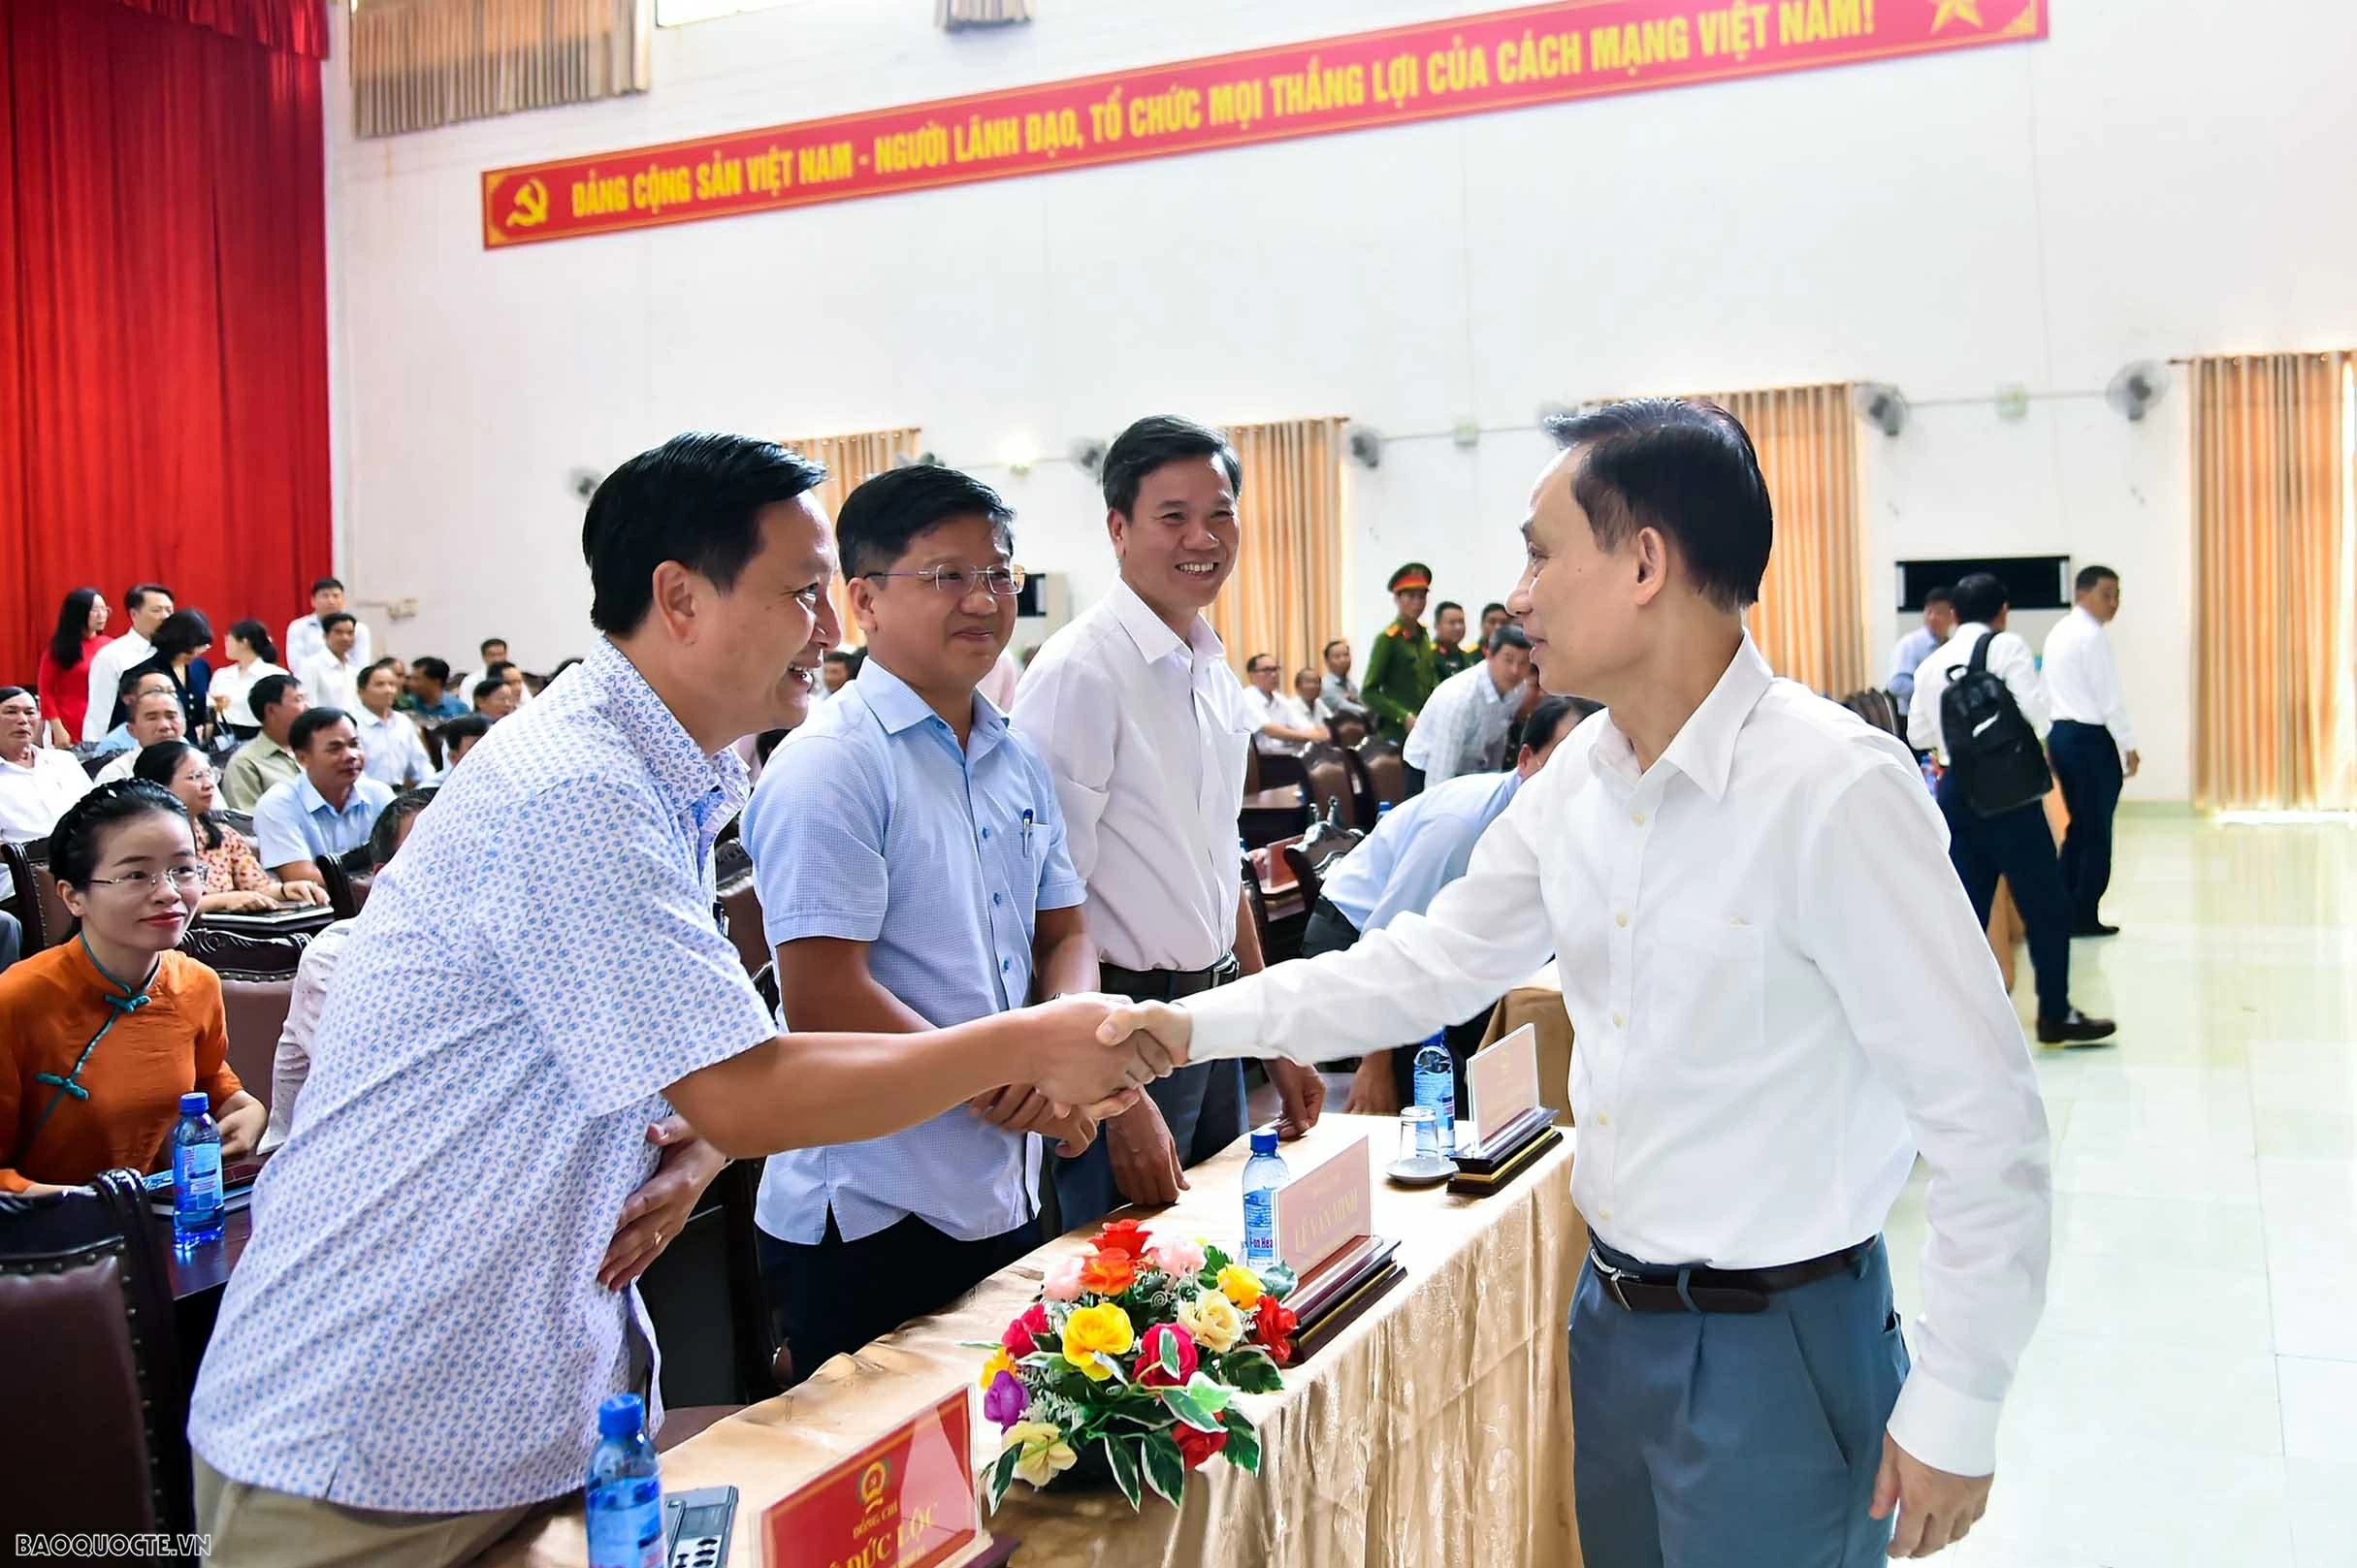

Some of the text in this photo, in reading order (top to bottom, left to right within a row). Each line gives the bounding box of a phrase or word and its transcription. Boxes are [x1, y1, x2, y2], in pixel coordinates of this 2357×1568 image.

[572, 172, 630, 217] ĐẢNG
[632, 163, 692, 214] CỘNG
[696, 151, 742, 200] SẢN
[746, 146, 793, 197] VIỆT
[798, 142, 854, 184] NAM
[875, 121, 950, 173] NGƯỜI
[953, 115, 1020, 163] LÃNH
[1024, 108, 1085, 157] ĐẠO,
[1089, 85, 1123, 143] TỔ
[1129, 83, 1203, 138] CHỨC
[1210, 78, 1264, 129] MỌI
[1271, 55, 1367, 117] THẮNG
[1372, 53, 1420, 109] LỢI
[1427, 35, 1490, 94] CỦA
[1497, 29, 1583, 84] CÁCH
[1591, 16, 1690, 77] MẠNG
[1699, 0, 1769, 62] VIỆT
[1780, 0, 1874, 45] NAM!
